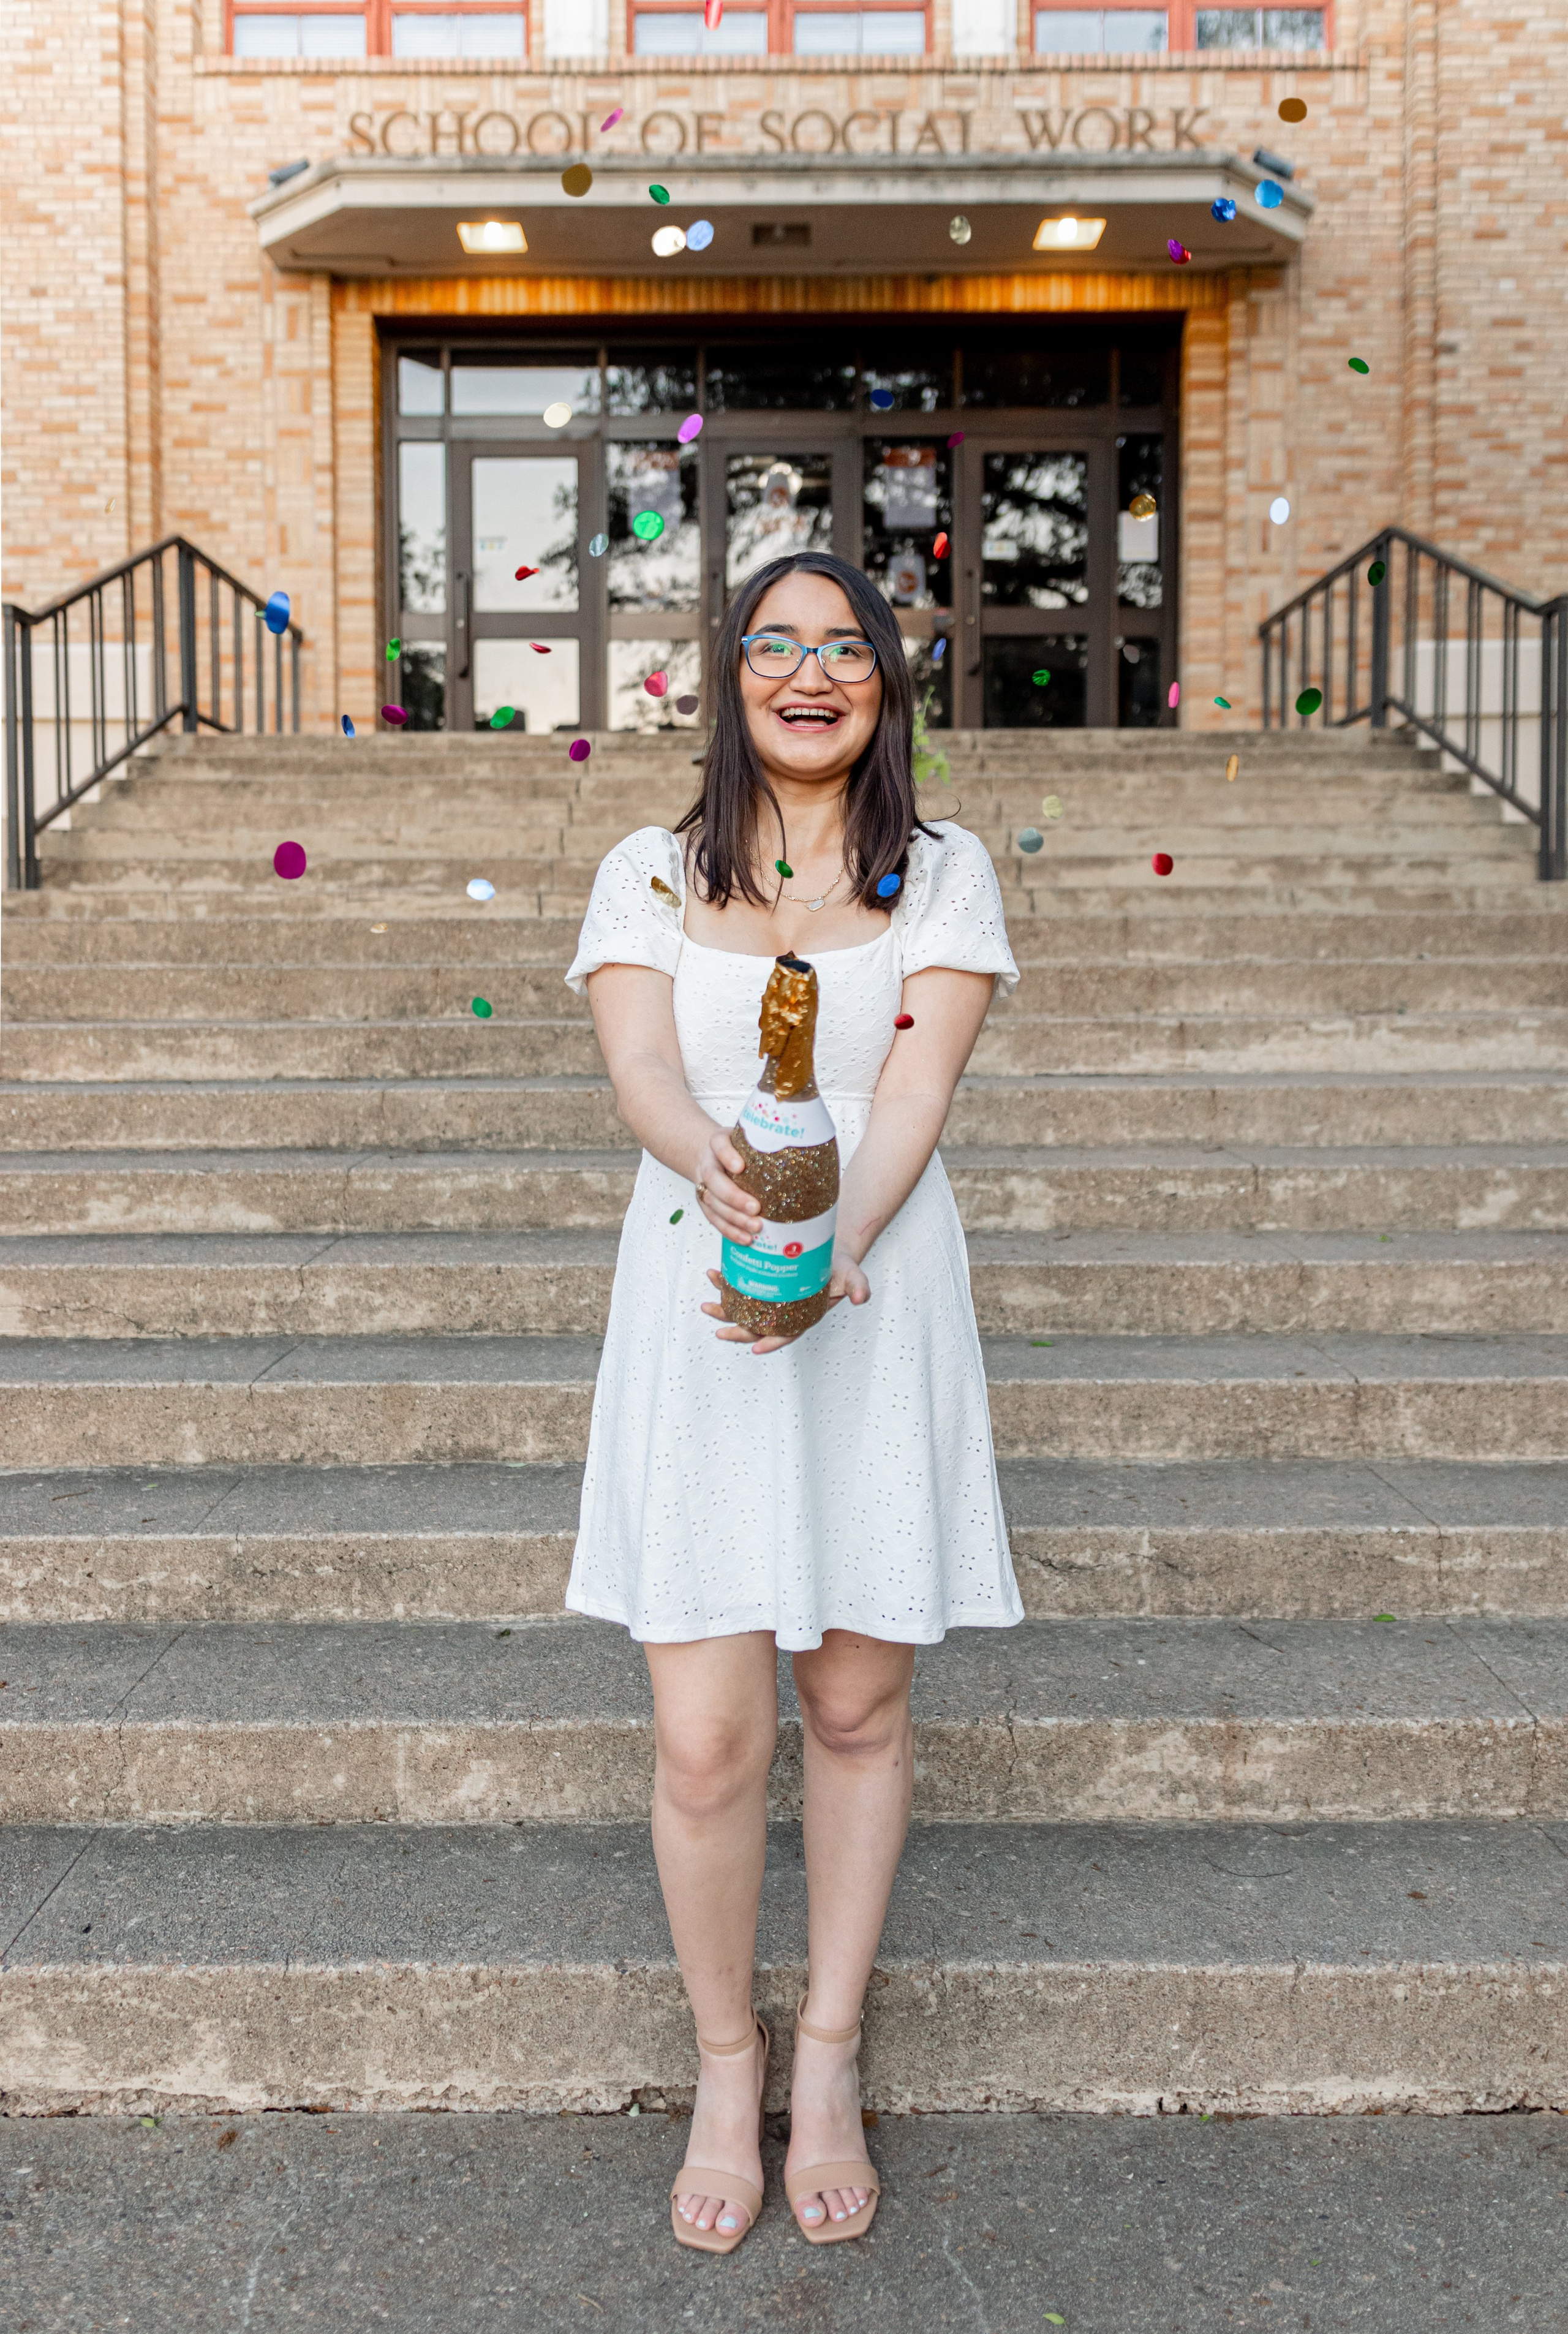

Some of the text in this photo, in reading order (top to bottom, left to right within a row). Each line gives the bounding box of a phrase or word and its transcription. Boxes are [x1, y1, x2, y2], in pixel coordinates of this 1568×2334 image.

[641, 110, 725, 154] OF
[1016, 109, 1210, 154] WORK
[764, 1260, 799, 1273] Popper
